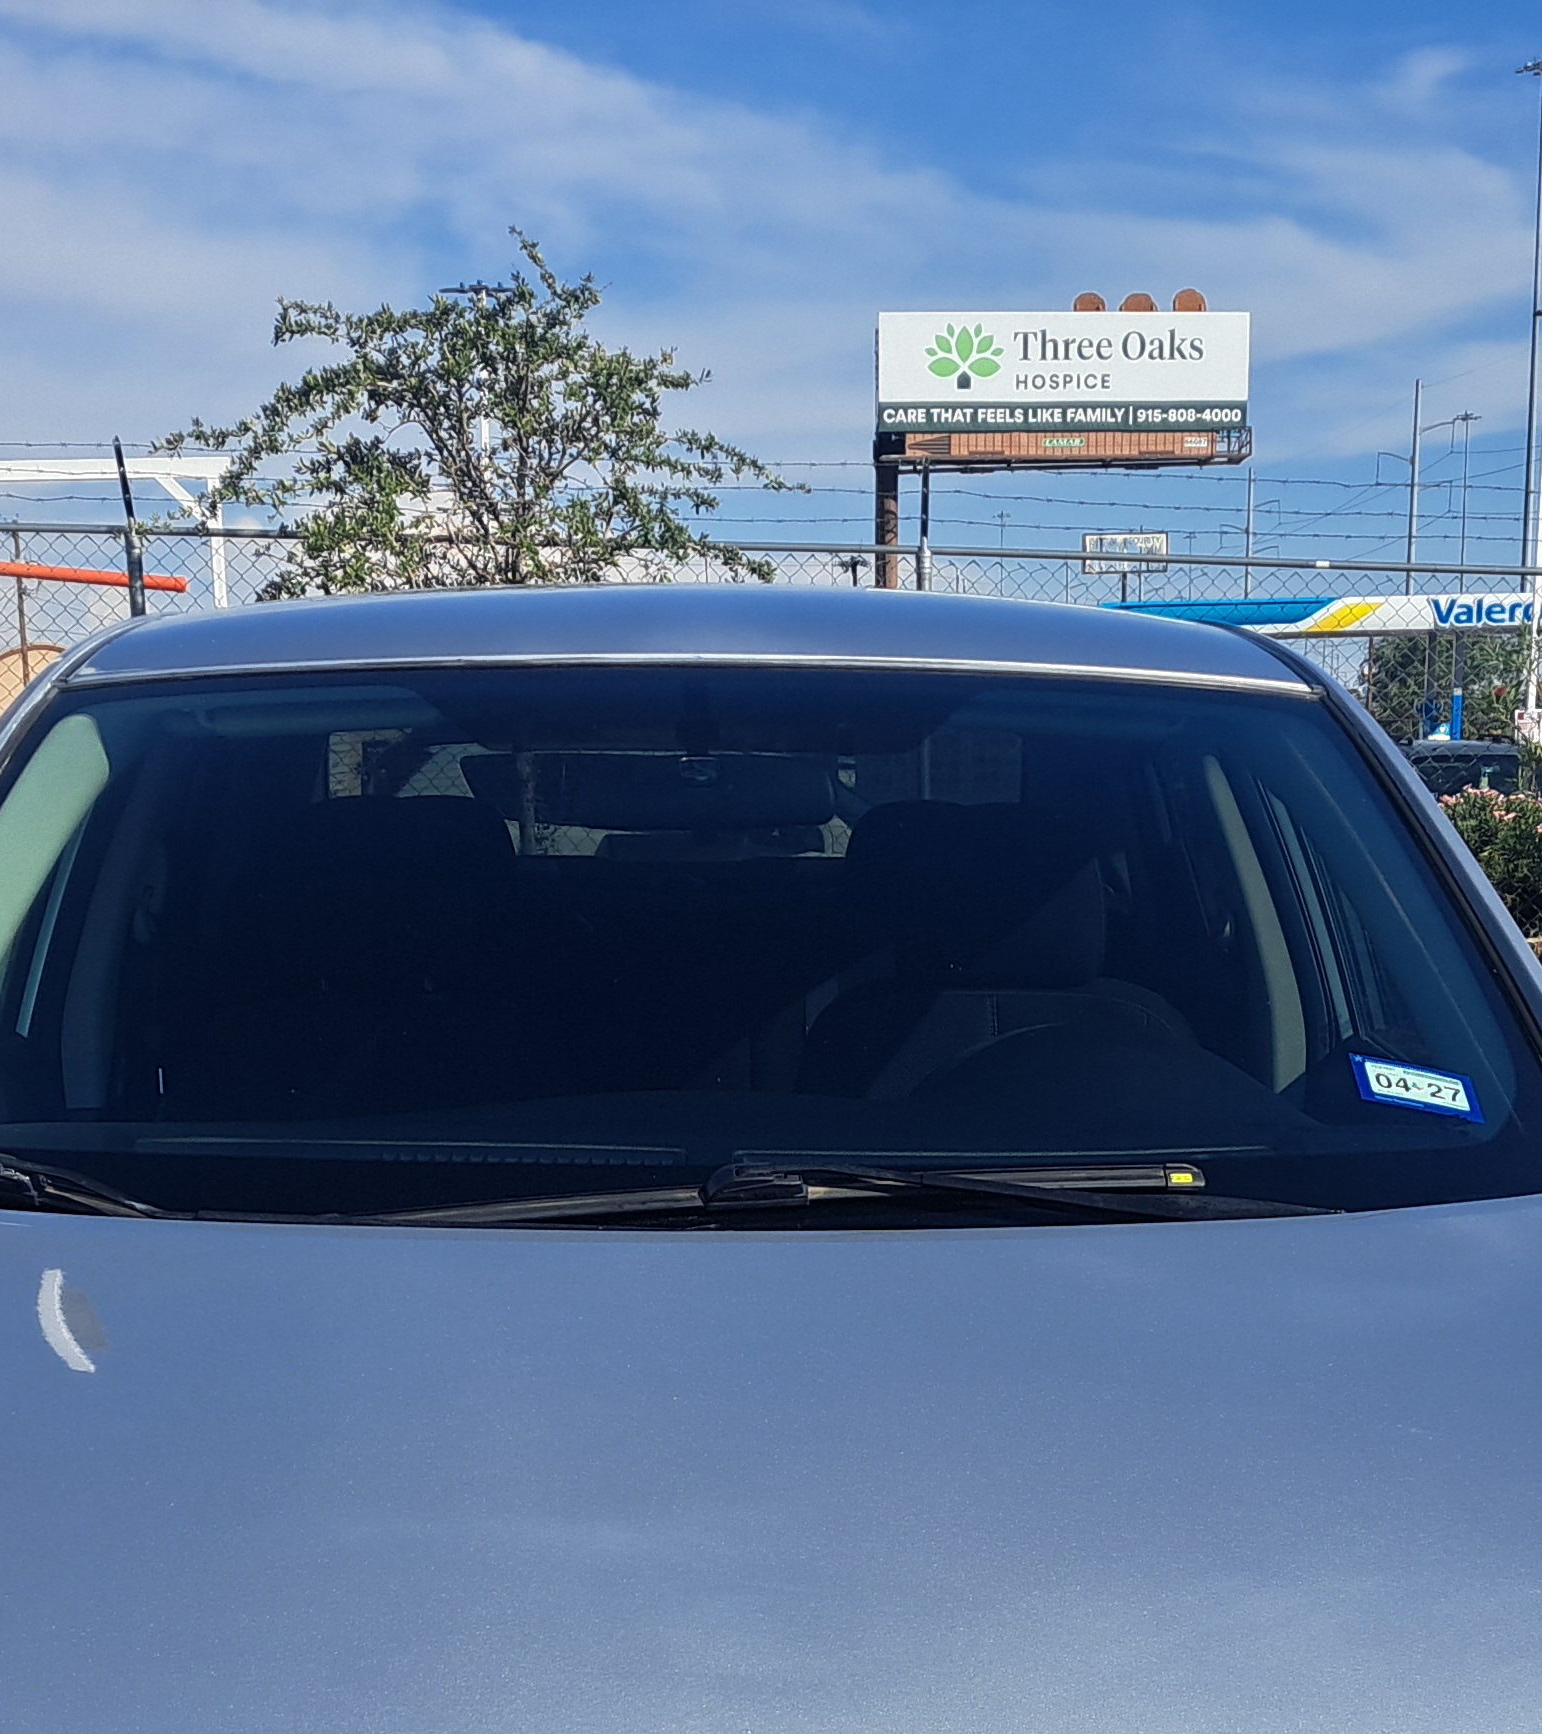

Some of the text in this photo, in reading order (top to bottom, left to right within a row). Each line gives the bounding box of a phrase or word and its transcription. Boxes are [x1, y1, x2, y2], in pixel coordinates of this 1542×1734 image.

[1013, 327, 1206, 362] Three Oaks
[1015, 373, 1111, 391] HOSPICE
[882, 406, 1241, 424] CARE THAT FEELS LIKE FAMILY 915-808-4000
[1374, 1072, 1411, 1093] 04
[1426, 1082, 1462, 1102] 27
